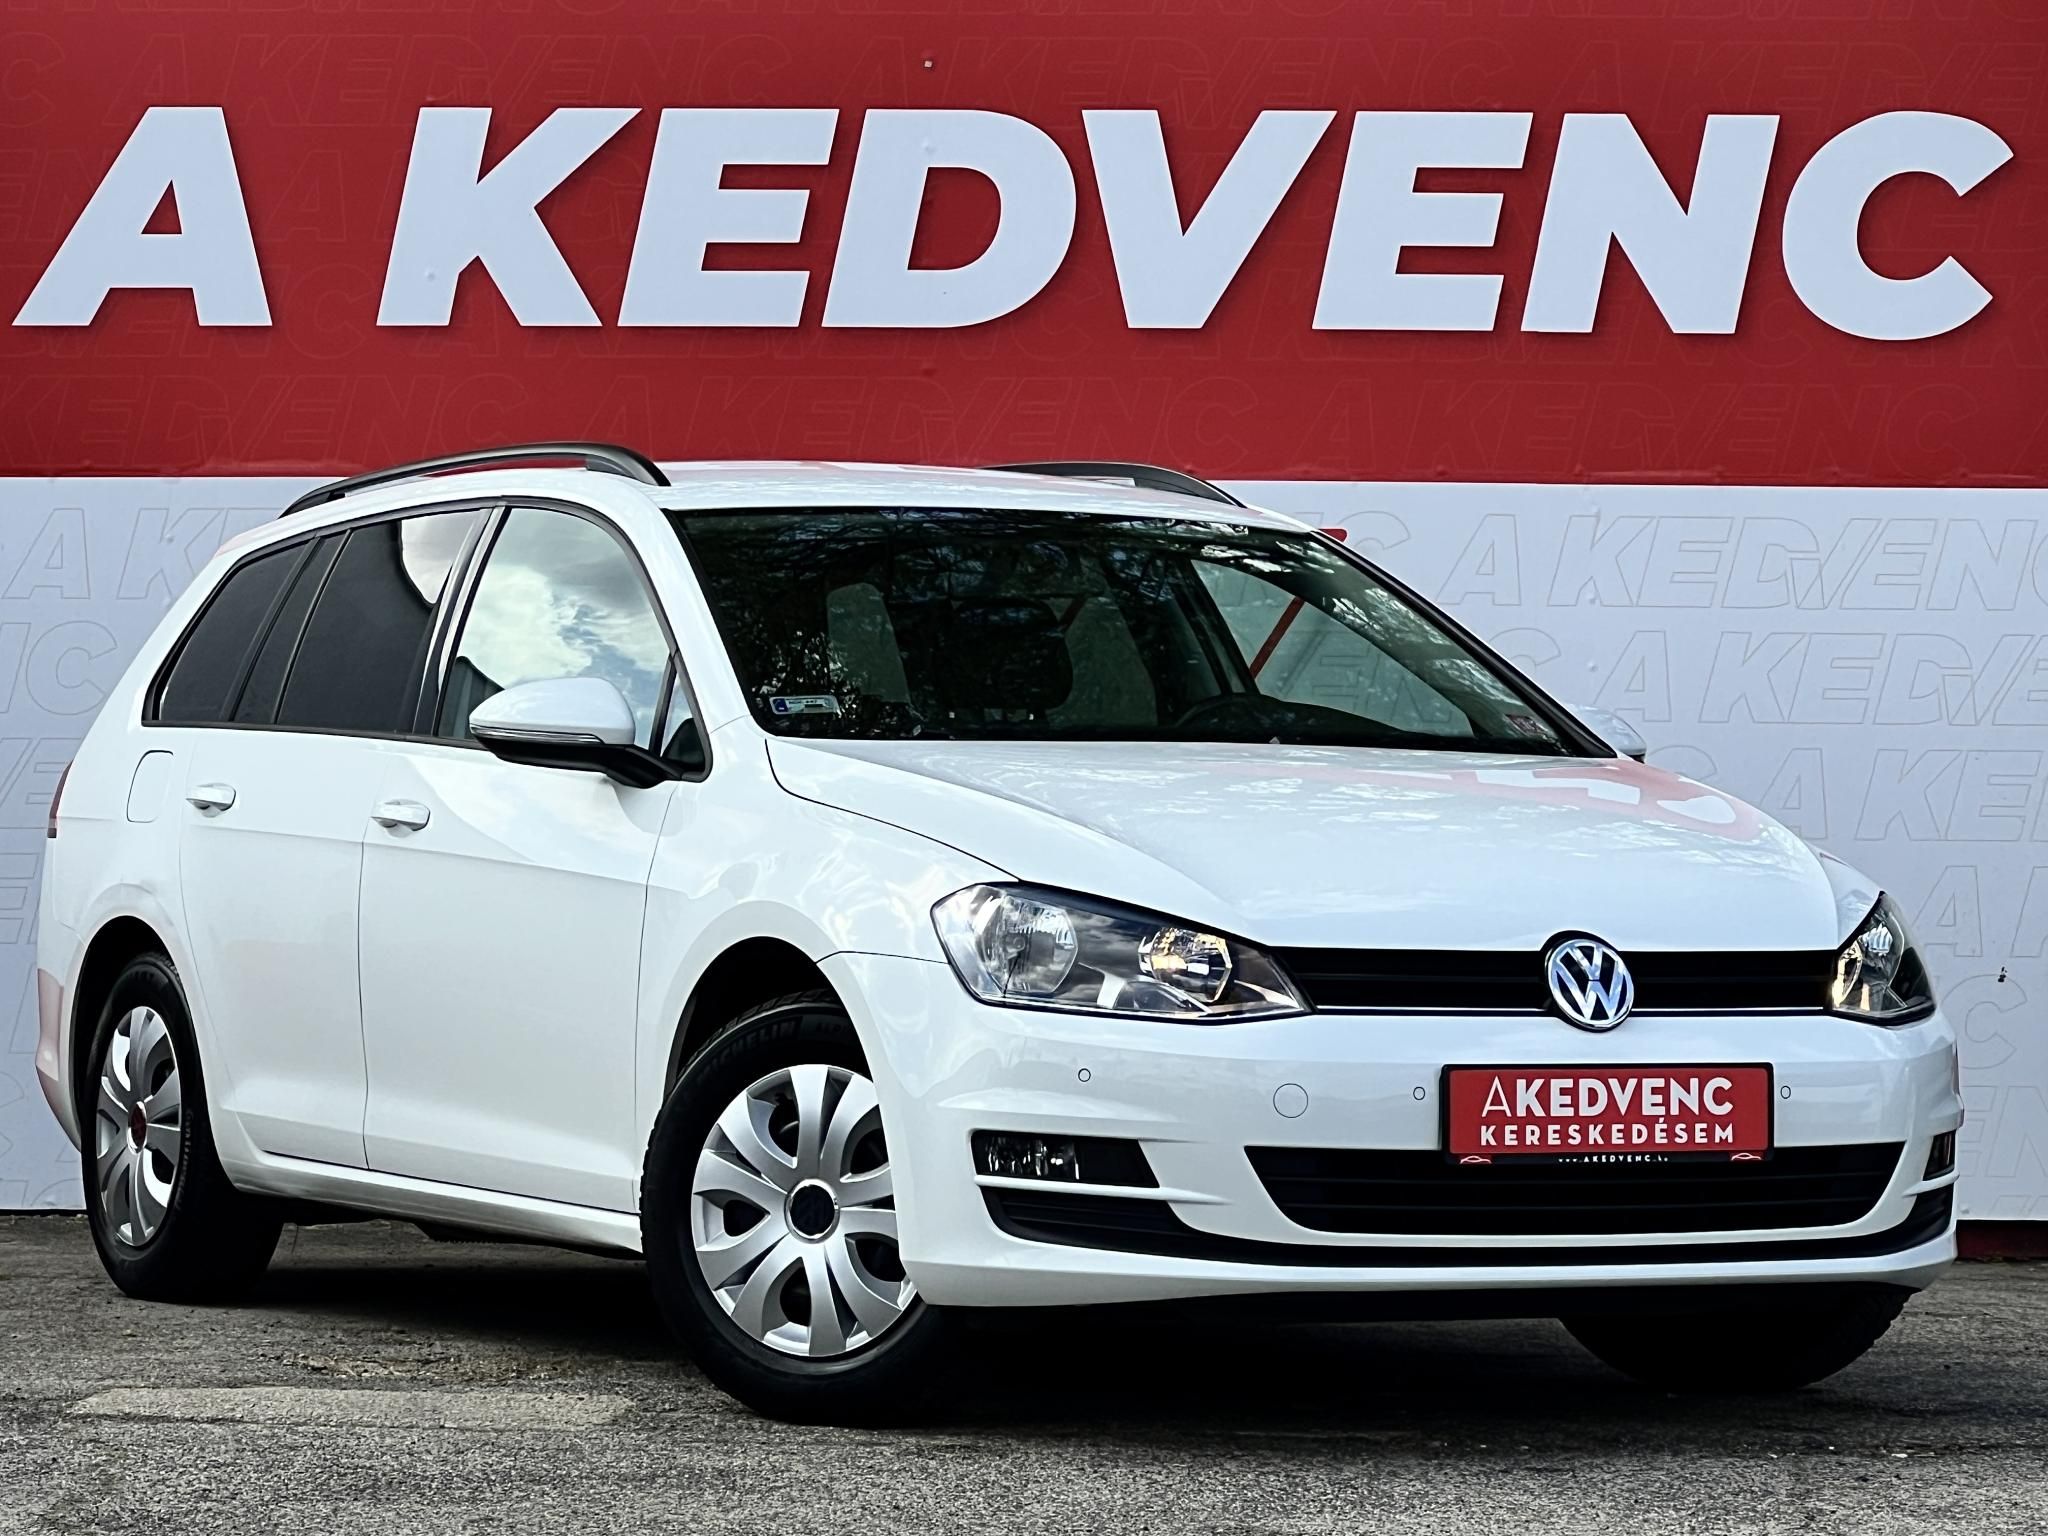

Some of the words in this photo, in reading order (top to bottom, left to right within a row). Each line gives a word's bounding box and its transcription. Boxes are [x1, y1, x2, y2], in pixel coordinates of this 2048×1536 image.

[11, 106, 273, 328] A
[375, 106, 2014, 342] KEDVENC
[1434, 512, 1523, 609] A
[1545, 514, 2048, 612] KEDVEN
[1480, 1118, 1734, 1147] KERESKEDÉSEM
